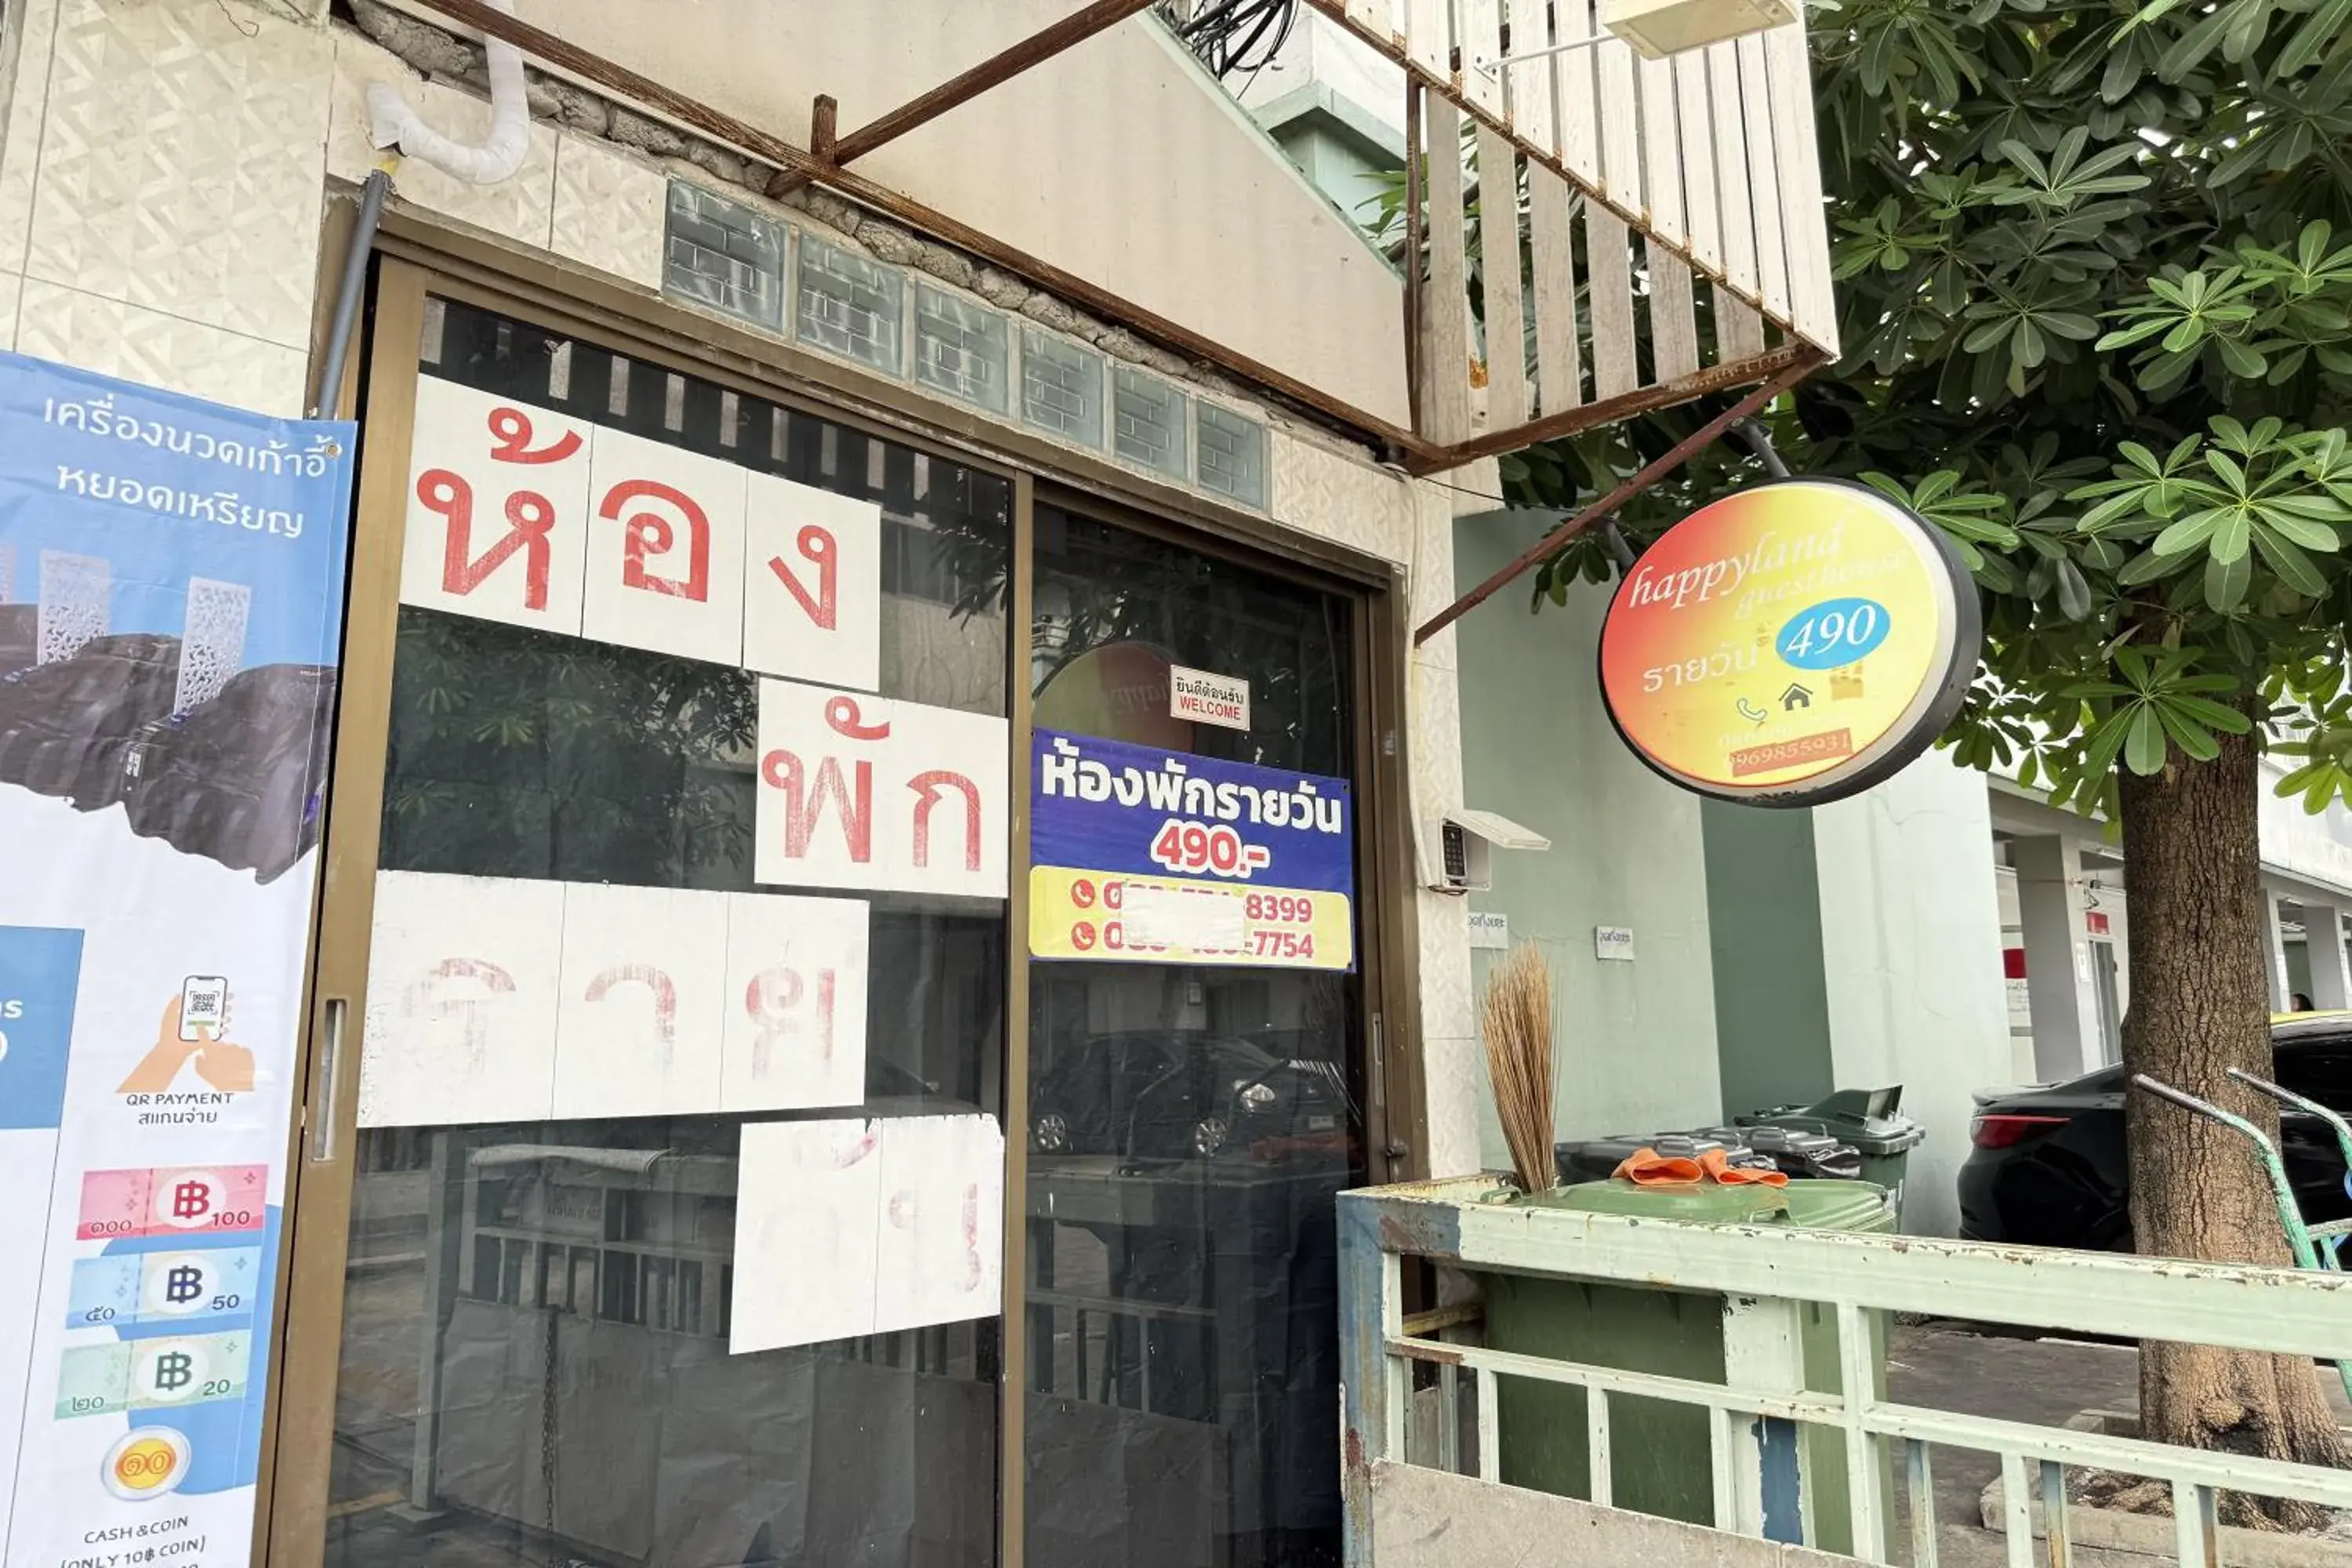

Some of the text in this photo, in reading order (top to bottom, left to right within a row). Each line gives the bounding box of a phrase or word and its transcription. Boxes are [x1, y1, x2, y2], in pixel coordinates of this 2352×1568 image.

[44, 394, 332, 477] เครื่องนวดเก้าอี้
[58, 466, 303, 539] หยอดเหรียญ
[416, 408, 836, 630] ห้อง
[1629, 514, 1848, 609] happyland
[1642, 604, 1877, 692] รายวัน 490
[1180, 695, 1241, 720] WELCOME
[762, 696, 982, 873] พัก
[1042, 739, 1341, 833] ห้องพักรายวัน
[1155, 823, 1267, 873] 490.-
[126, 1093, 234, 1105] QR PAYMENT
[138, 1107, 217, 1124] สแกนจ่าย
[212, 1211, 250, 1227] 100
[212, 1295, 239, 1310] 50
[203, 1380, 230, 1396] 20
[84, 1527, 132, 1544] CASH
